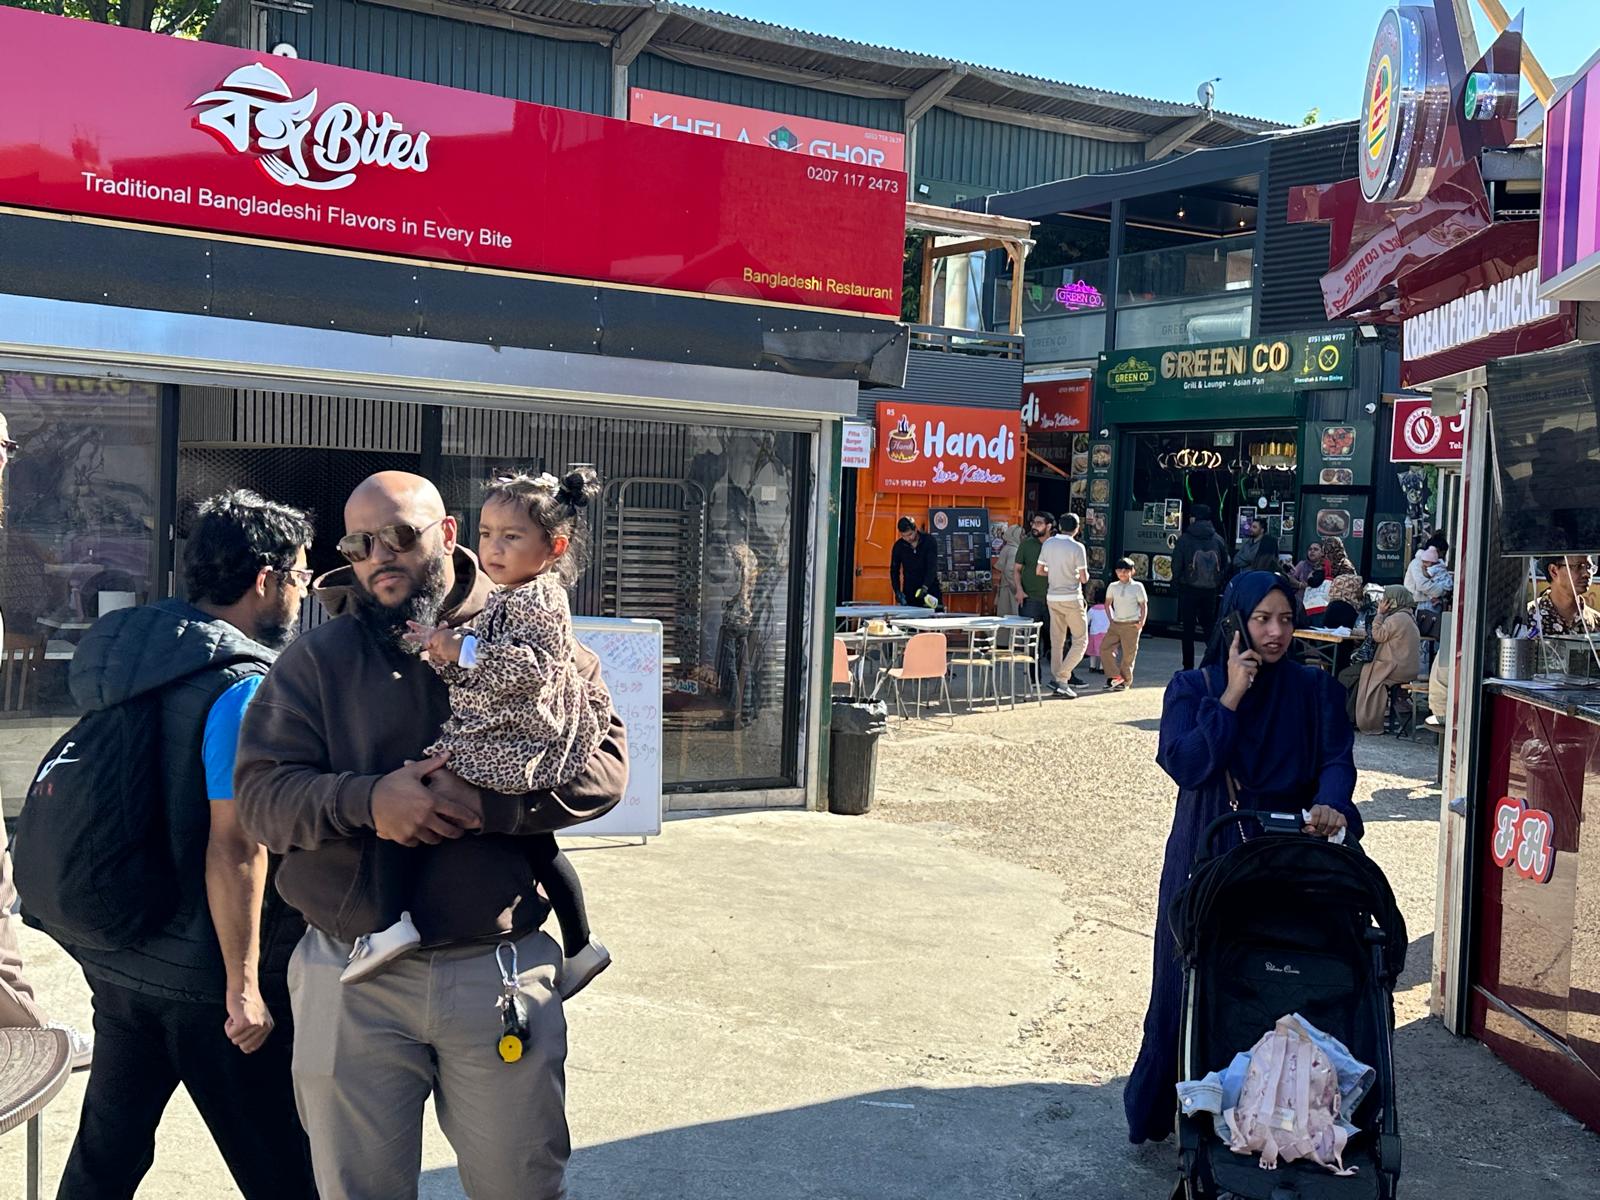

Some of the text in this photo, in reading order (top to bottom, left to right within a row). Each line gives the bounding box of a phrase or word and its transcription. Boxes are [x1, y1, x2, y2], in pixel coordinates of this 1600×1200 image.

[312, 101, 431, 173] Bites
[808, 139, 885, 168] GHOR
[807, 166, 899, 193] 0207 117 2473
[81, 171, 512, 249] Traditional Bangladeshi Flavors in Every Bite
[743, 267, 893, 300] Bangladeshi Restaurant
[1059, 291, 1101, 305] GREEN CO
[1404, 303, 1450, 359] KOREAN
[1450, 289, 1484, 345] FRIED
[1160, 341, 1290, 379] GREEN CO
[1115, 372, 1149, 382] GREEN CO
[1183, 381, 1197, 390] Grill
[1197, 381, 1203, 389] &
[1204, 380, 1226, 389] Lounge
[1233, 378, 1251, 387] Asian
[1252, 377, 1264, 386] Pan
[923, 420, 1015, 464] Handi
[932, 461, 958, 483] Live
[959, 462, 1005, 484] Kitchen
[958, 518, 981, 528] MENU
